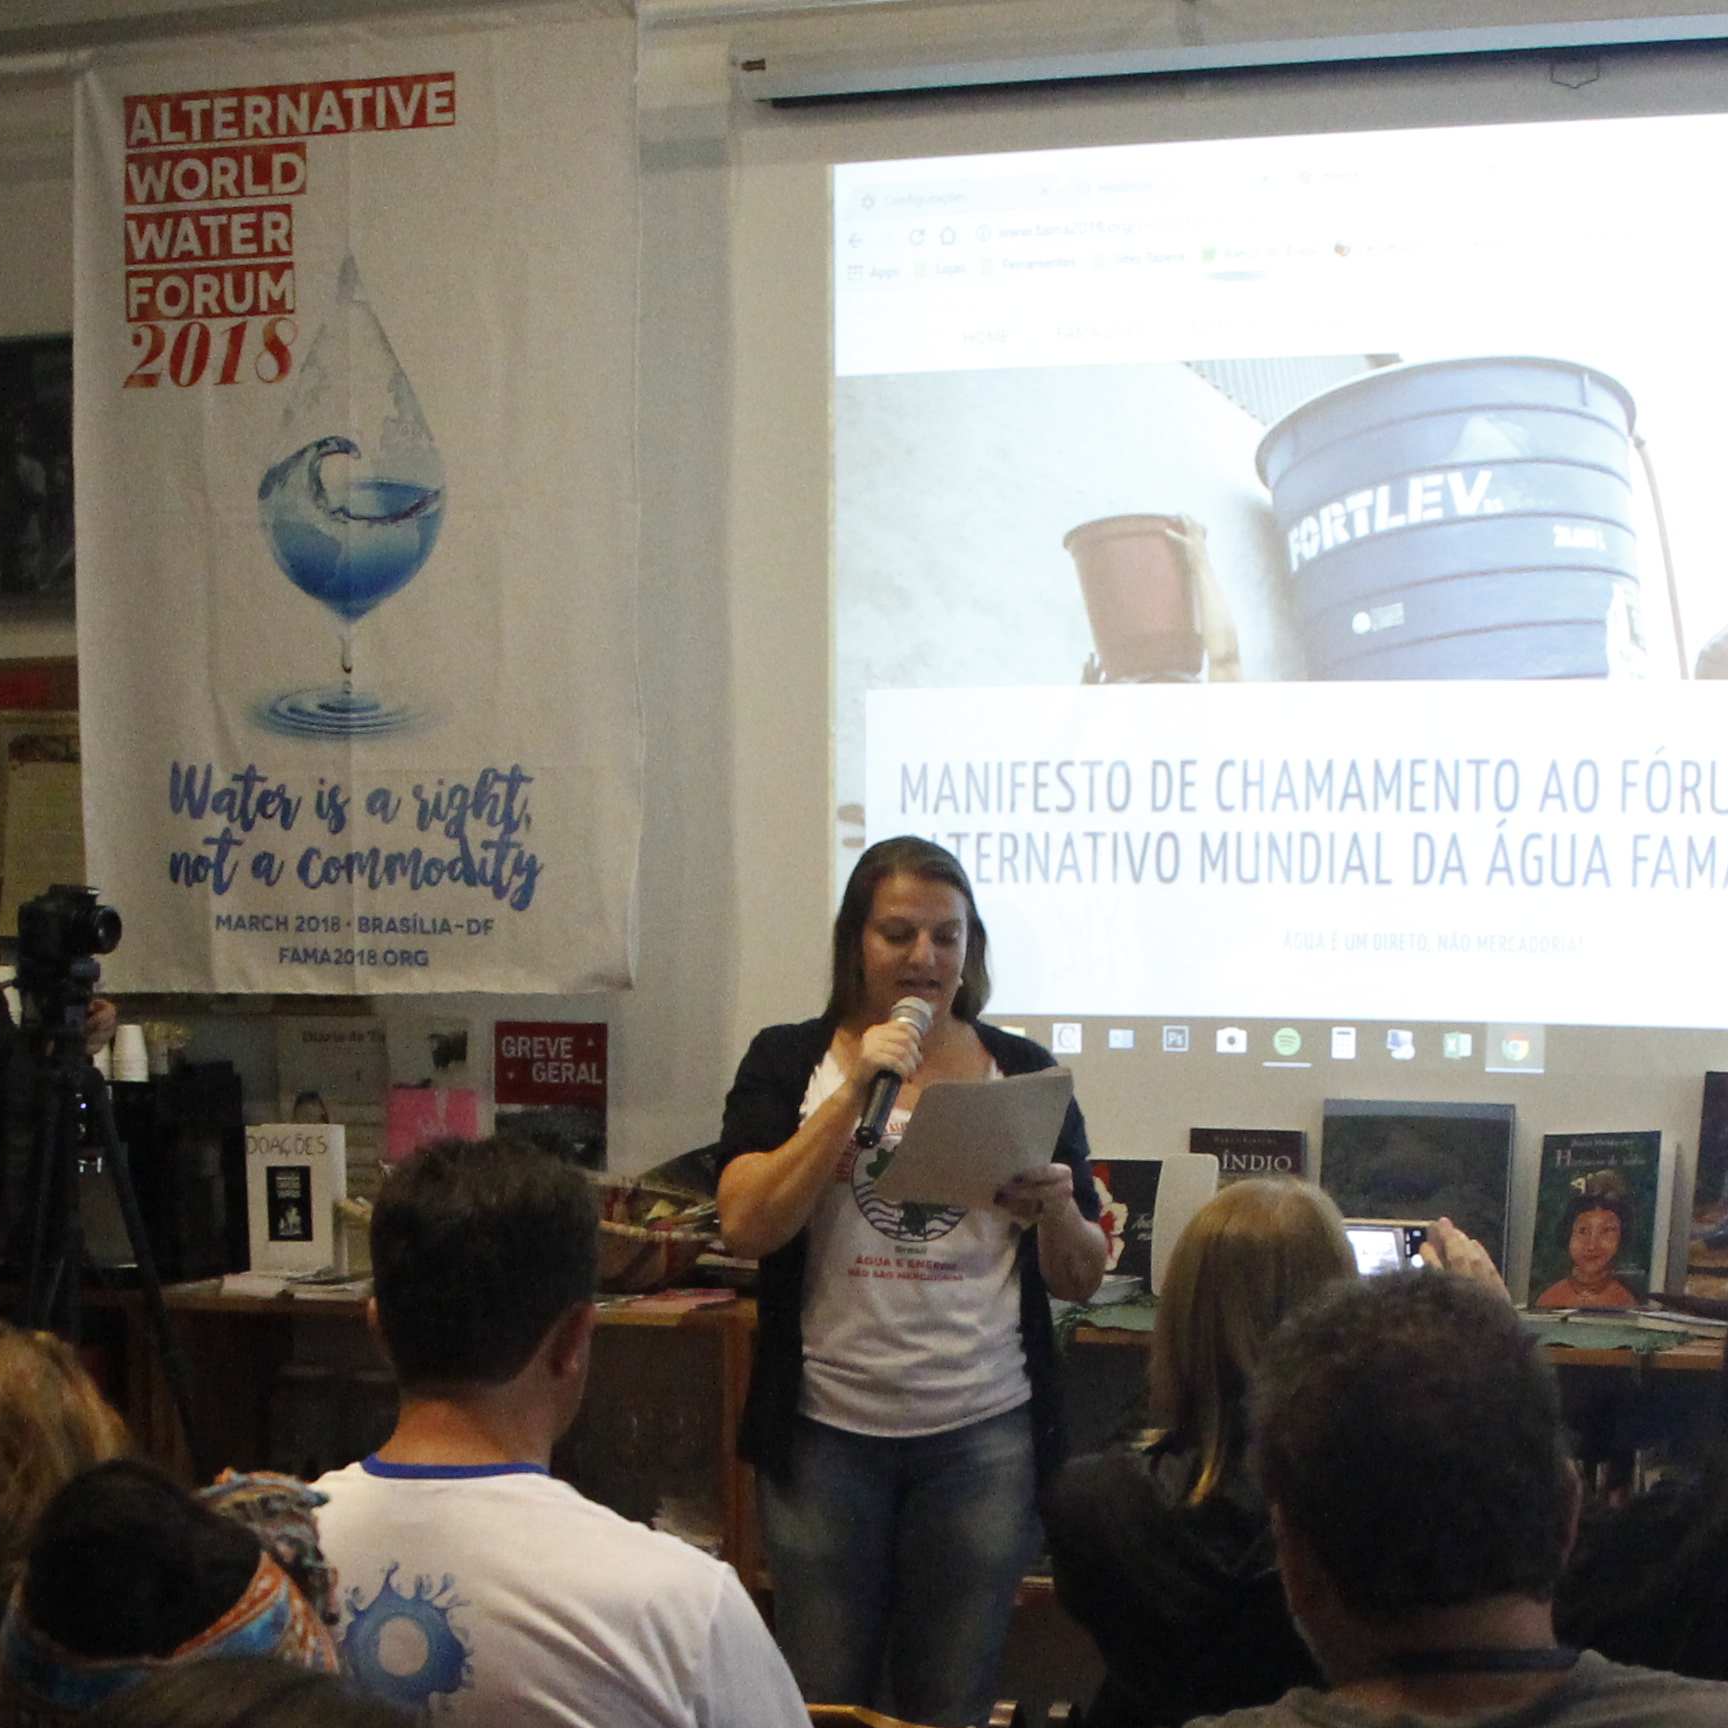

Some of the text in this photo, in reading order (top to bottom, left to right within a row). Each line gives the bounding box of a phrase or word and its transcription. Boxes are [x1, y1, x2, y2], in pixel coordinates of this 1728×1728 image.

[127, 80, 456, 146] ALTERNATIVE
[127, 151, 307, 203] WORLD
[126, 211, 292, 262] WATER
[128, 270, 296, 320] FORUM
[123, 316, 299, 390] 2018
[1287, 470, 1493, 574] FORTLEV
[171, 761, 535, 840] Water is a right,
[900, 760, 1132, 816] MANIFESTO
[1151, 760, 1199, 814] DE
[1215, 758, 1521, 815] CHAMAMENTO
[1538, 758, 1601, 815] AO
[170, 827, 545, 912] not a commodity
[912, 831, 1181, 886] TERNATIVO
[1199, 831, 1394, 886] MUNDIAL
[1412, 831, 1469, 886] DA
[1486, 817, 1612, 889] ÁGUA
[216, 912, 494, 936] MARCH 2018 BRASÍLIA-DF
[1283, 925, 1326, 952] ÁGUA
[1344, 931, 1368, 952] UM
[1437, 928, 1472, 953] NÃO
[278, 947, 429, 967] FAMA2018.ORG
[500, 1035, 574, 1060] GREVE
[531, 1061, 604, 1086] GERAL
[247, 1133, 329, 1157] DOAÇÕES
[1221, 1149, 1293, 1172] ÍNDIO
